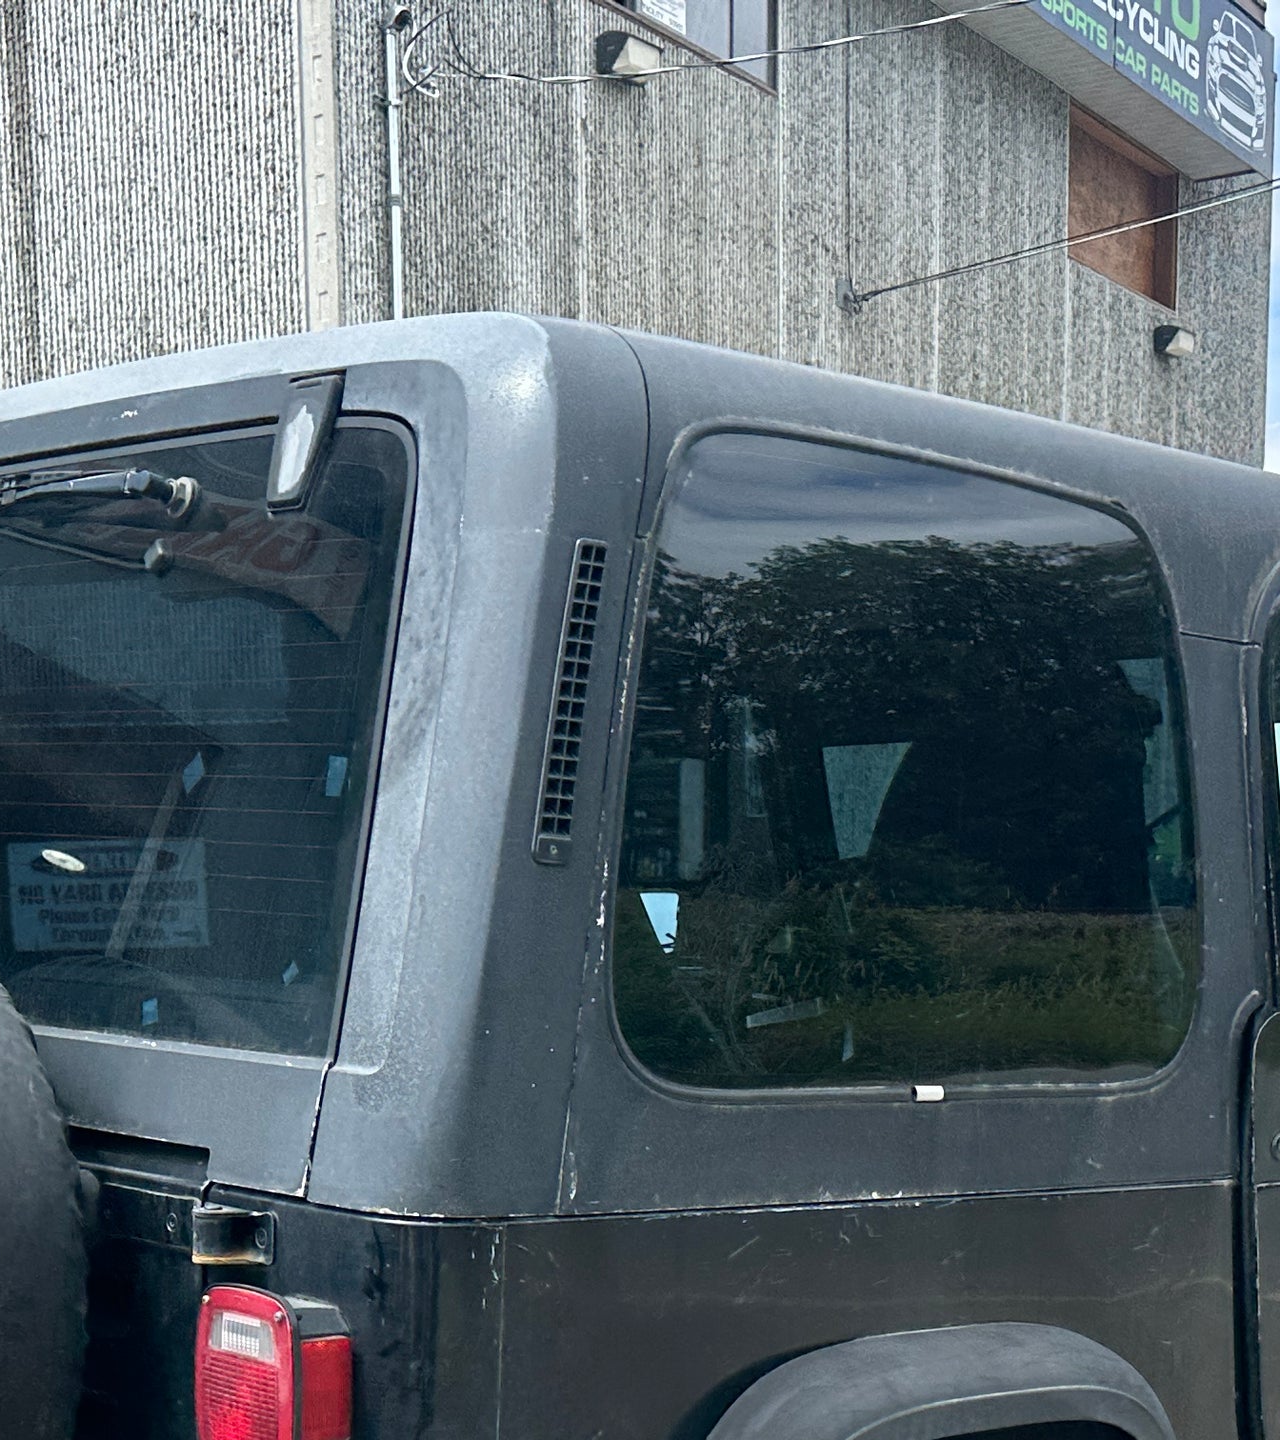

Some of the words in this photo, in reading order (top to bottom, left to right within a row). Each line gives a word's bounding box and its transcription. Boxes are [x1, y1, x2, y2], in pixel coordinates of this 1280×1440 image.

[1093, 0, 1199, 79] CYCLING
[1114, 35, 1147, 79] CAR
[1152, 63, 1199, 115] PARTS
